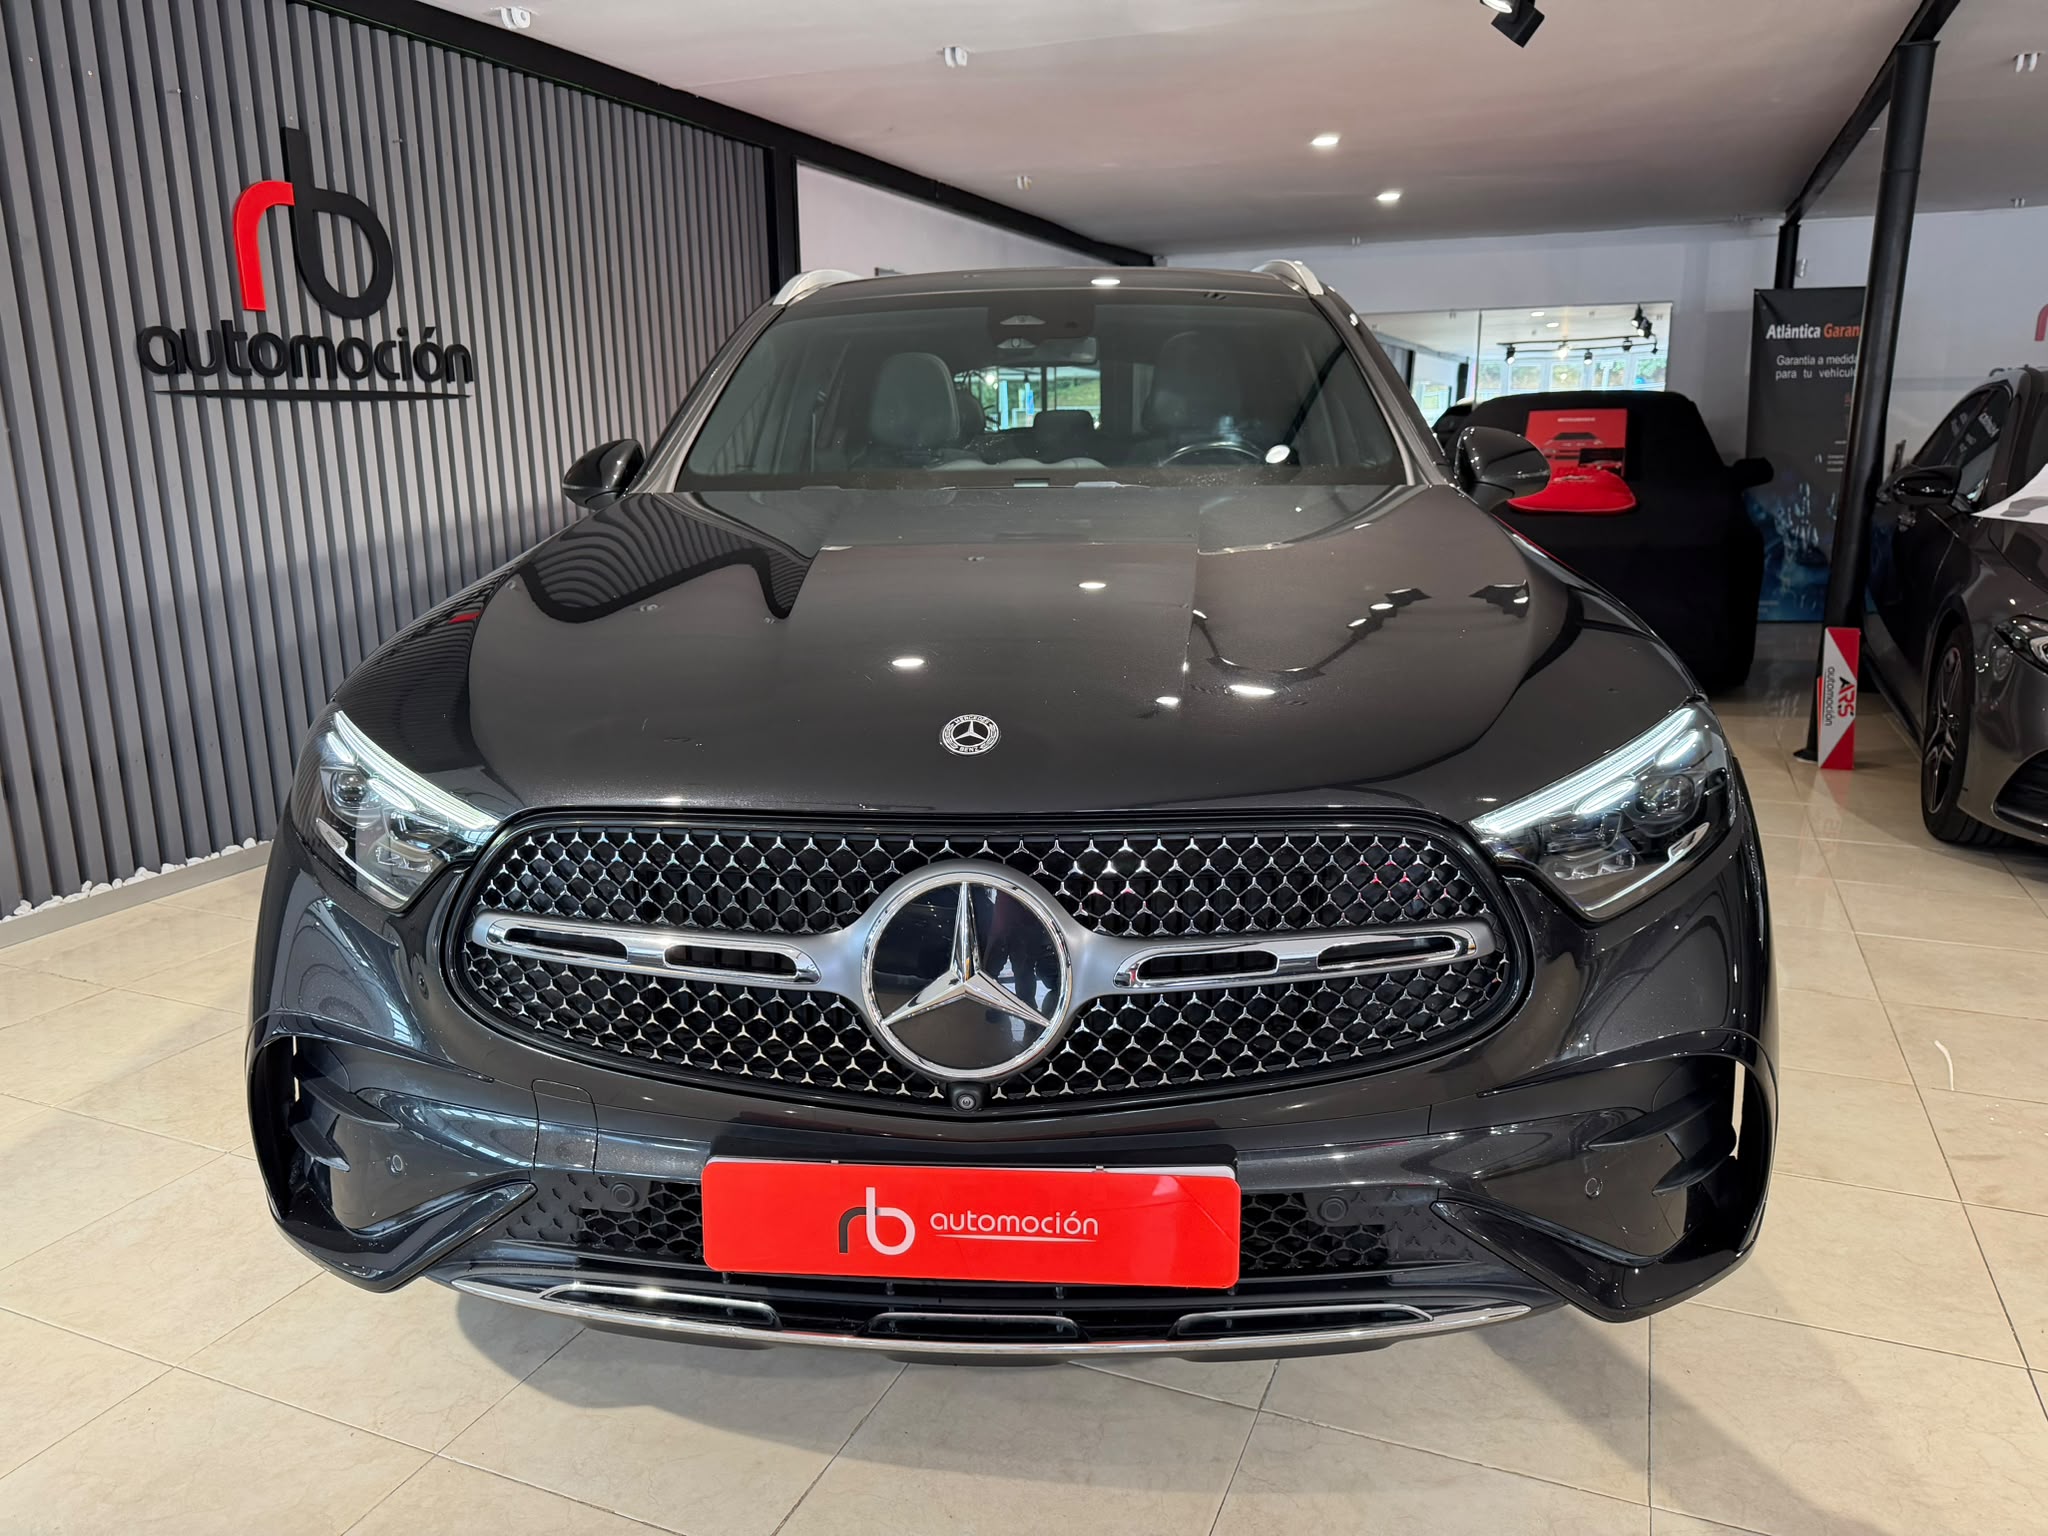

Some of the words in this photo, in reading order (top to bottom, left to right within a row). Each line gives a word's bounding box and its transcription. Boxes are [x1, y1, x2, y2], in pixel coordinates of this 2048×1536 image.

[233, 126, 394, 320] rb
[137, 319, 474, 383] automoción
[1765, 323, 1821, 339] Atlántica
[1823, 322, 1861, 338] Garan
[1817, 356, 1824, 365] a
[1775, 369, 1797, 380] para
[1803, 368, 1813, 378] tu
[1824, 666, 1835, 727] automoción
[838, 1187, 916, 1256] rb
[929, 1211, 1099, 1236] automoción
